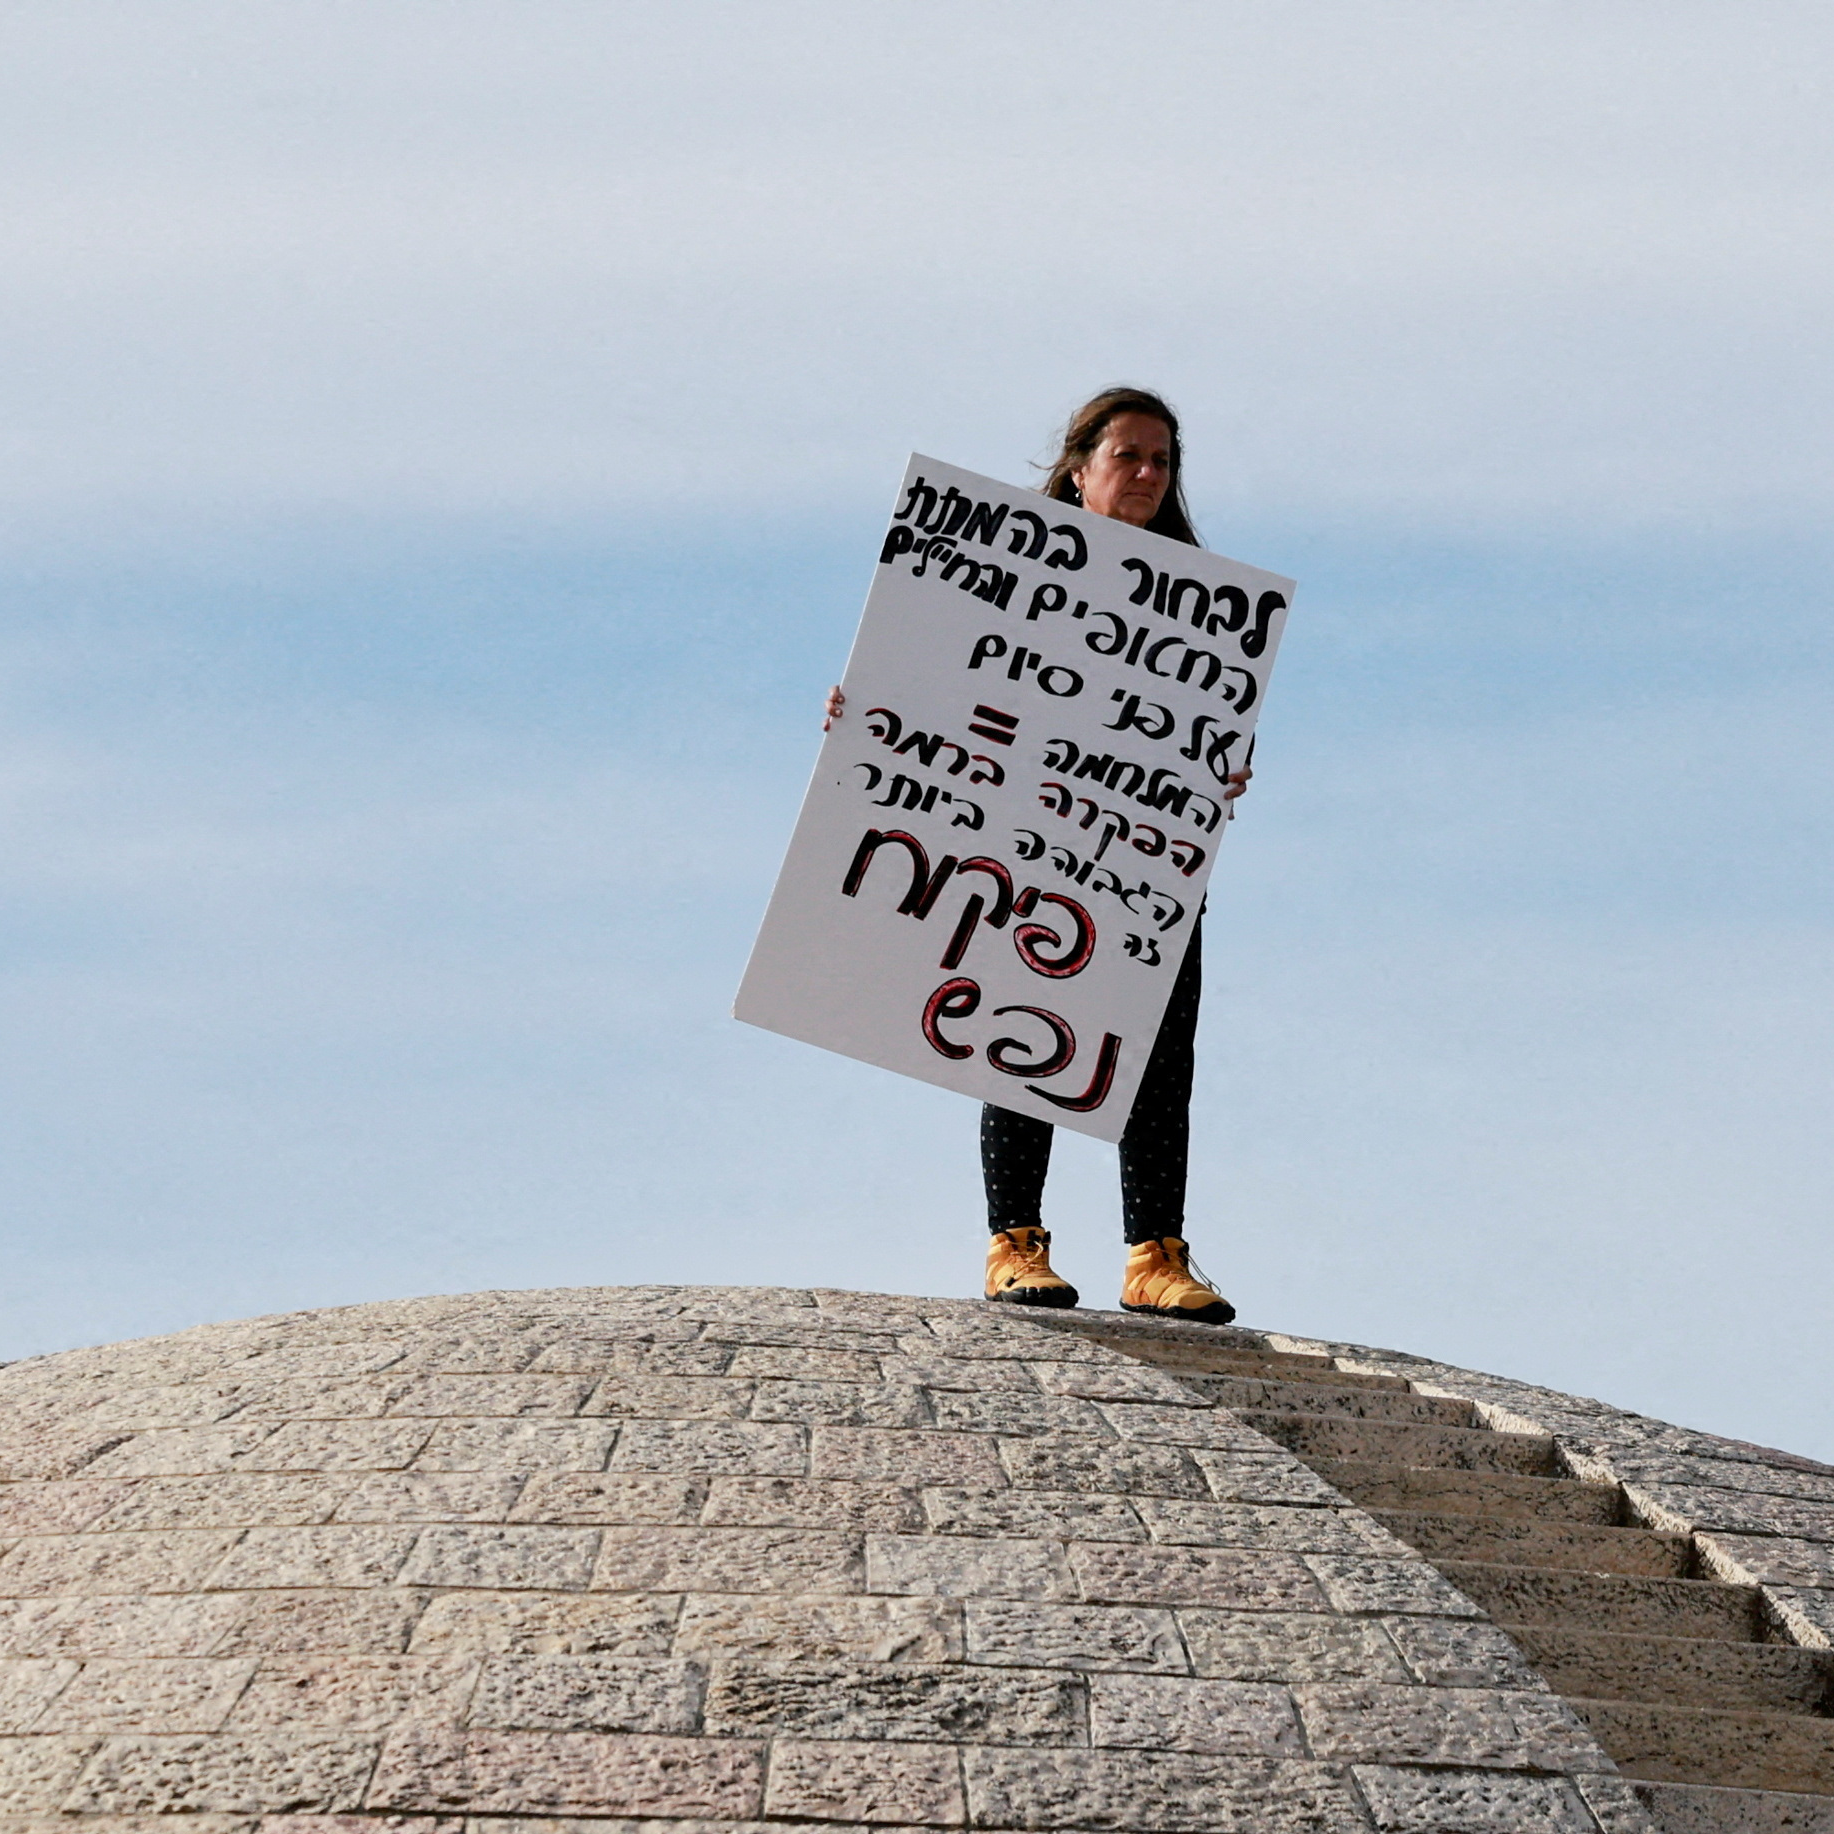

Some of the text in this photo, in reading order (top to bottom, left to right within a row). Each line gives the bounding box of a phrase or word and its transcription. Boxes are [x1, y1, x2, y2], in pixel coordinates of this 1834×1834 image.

[879, 524, 1258, 716] החטופים והחיילים
[1120, 557, 1287, 659] לבחור
[967, 634, 1242, 786] על פני סיום
[853, 762, 1187, 933] הגבוהה ביותר
[864, 707, 1207, 878] הפקרה ברמה
[1042, 738, 1222, 835] המלחמה
[841, 828, 1162, 980] זה פיקוח
[921, 976, 1123, 1113] נפש
